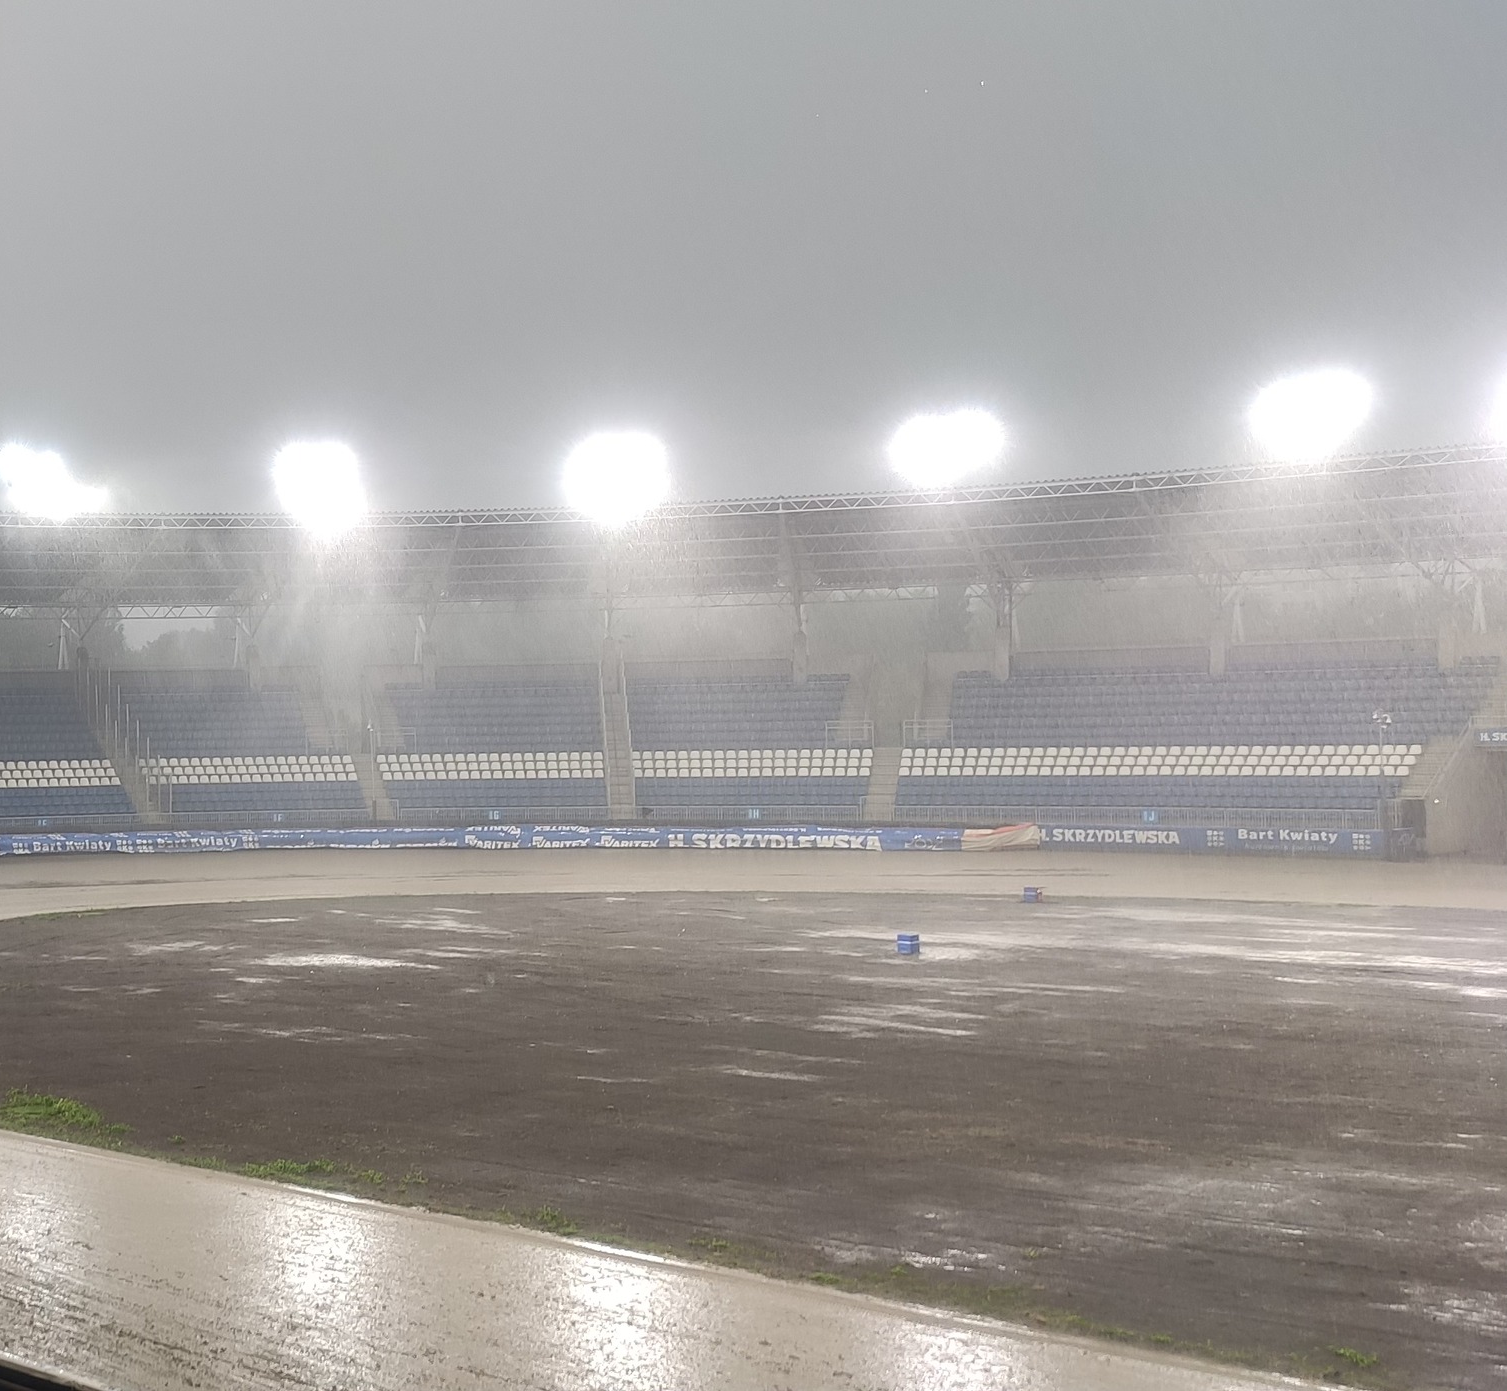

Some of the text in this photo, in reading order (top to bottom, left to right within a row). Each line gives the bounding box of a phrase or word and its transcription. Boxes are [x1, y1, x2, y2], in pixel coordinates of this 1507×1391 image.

[602, 837, 660, 848] VARITEX
[691, 833, 883, 851] SKRZYDLEWSKA
[1052, 828, 1180, 844] SKRZYDLEWSKA
[1237, 828, 1338, 843] Bart Kwiaty
[33, 839, 112, 853] Bart Kwiaty
